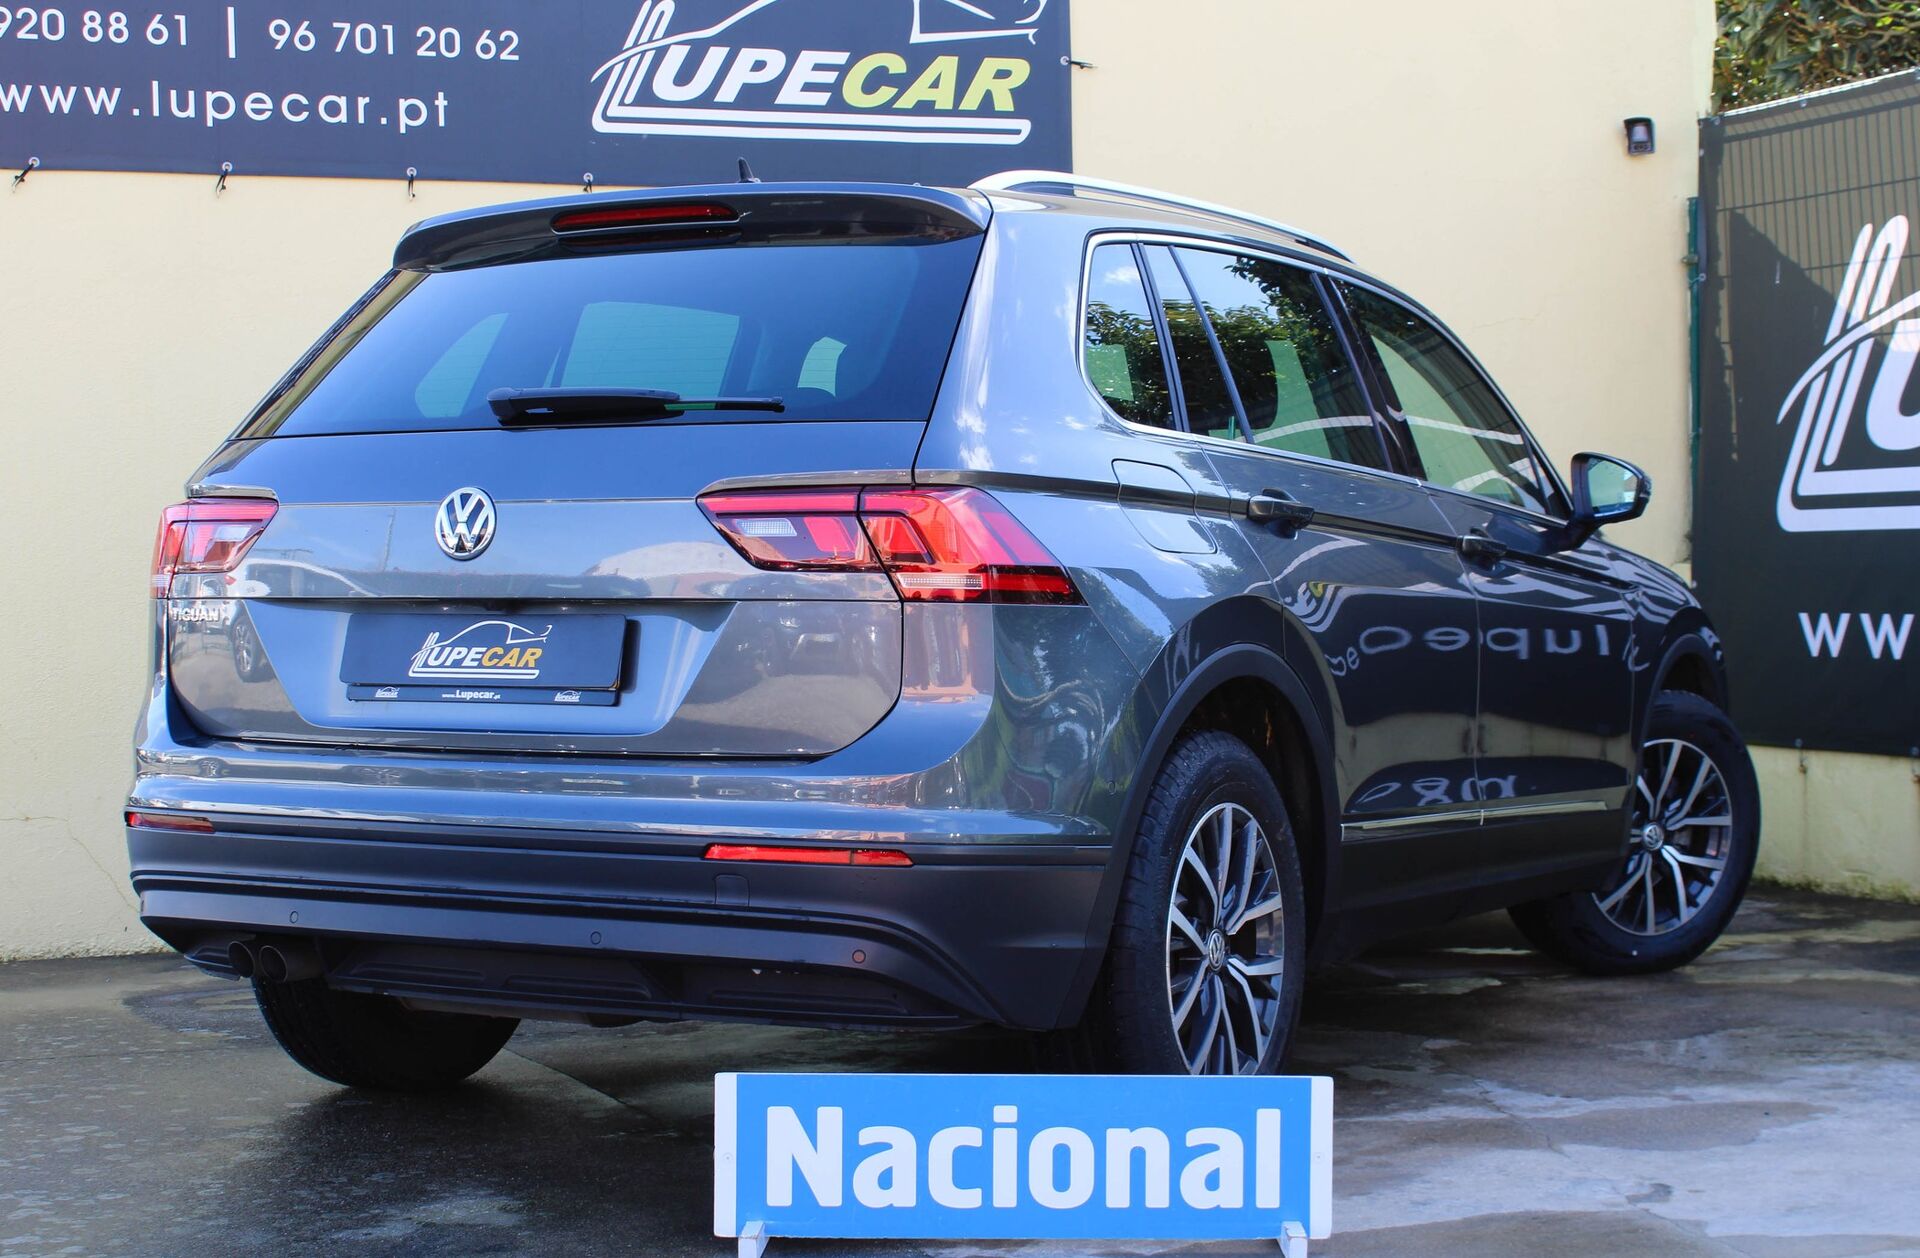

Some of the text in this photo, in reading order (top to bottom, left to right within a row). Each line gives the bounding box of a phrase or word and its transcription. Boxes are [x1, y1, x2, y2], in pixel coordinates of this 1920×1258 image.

[82, 10, 129, 44] 88
[146, 13, 188, 46] 61
[268, 18, 316, 52] 96
[332, 22, 395, 55] 701
[416, 26, 461, 58] 20
[475, 29, 519, 61] 62
[0, 80, 448, 134] www.lupecar.pt
[172, 607, 219, 622] TIGUAN
[408, 631, 542, 679] LUPECAR
[766, 1104, 1281, 1210] Nacional
